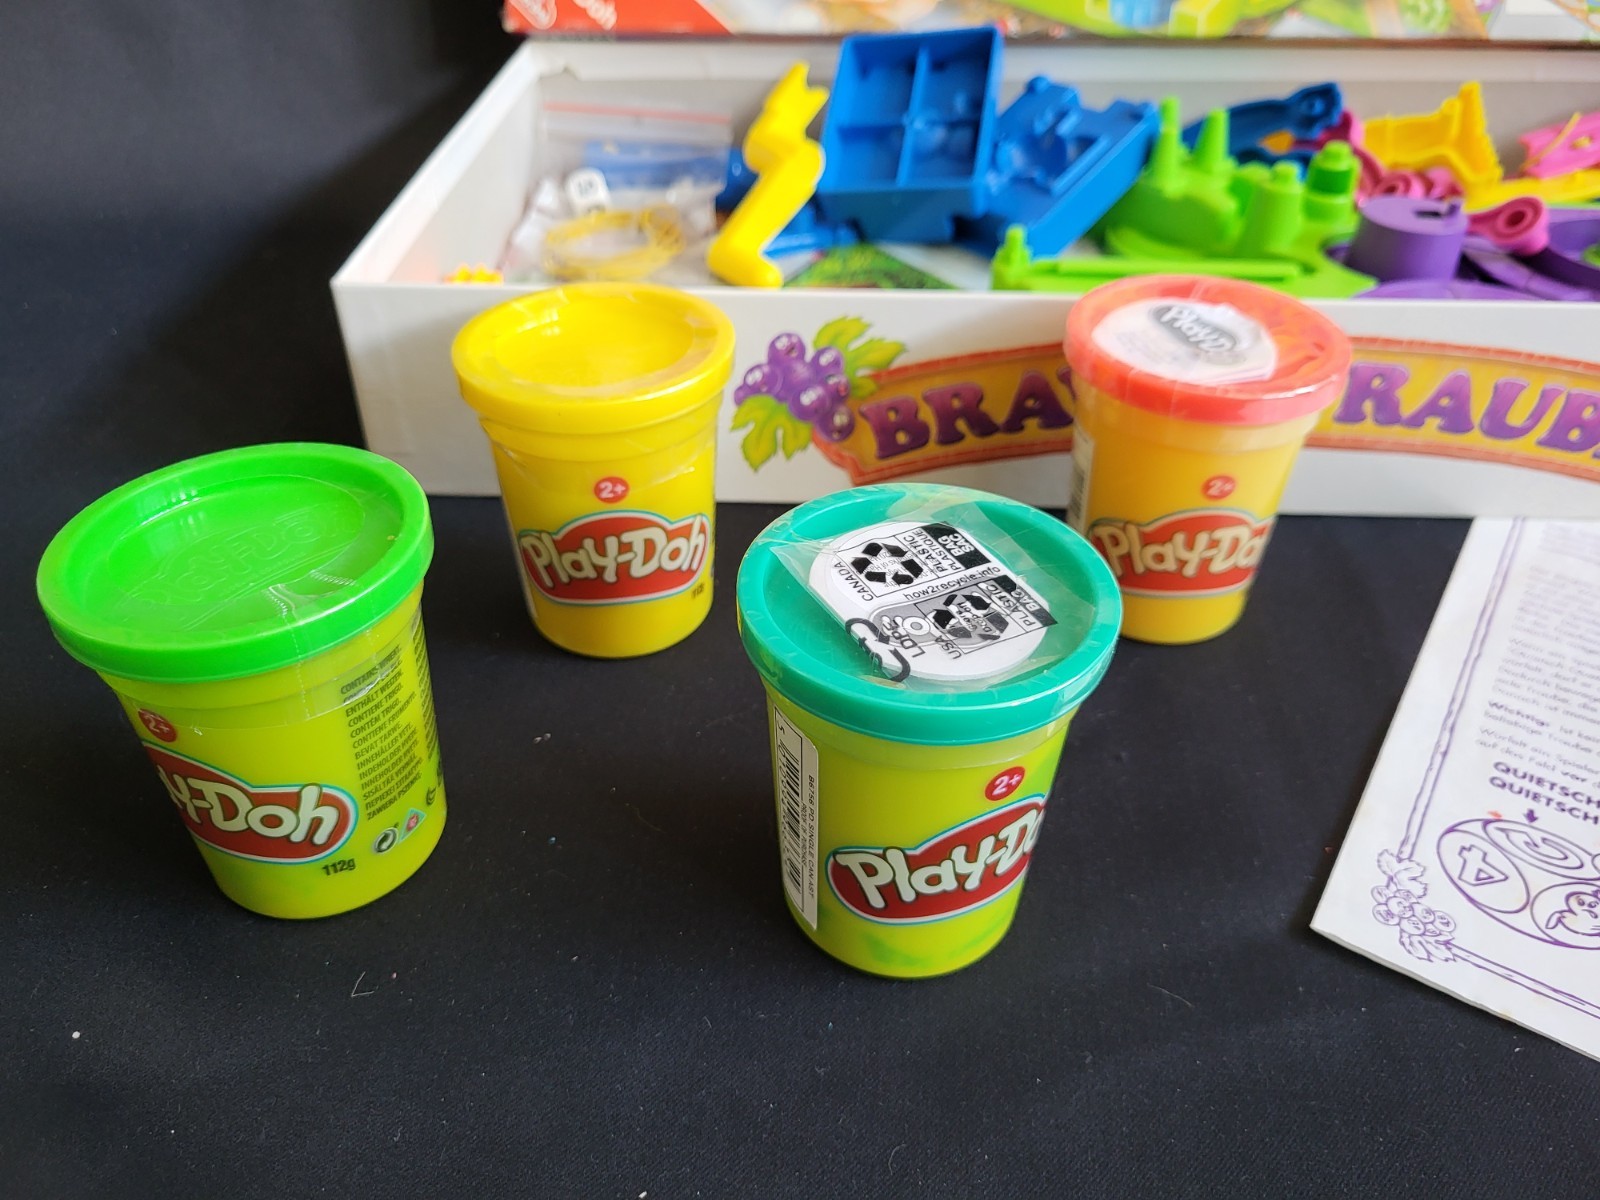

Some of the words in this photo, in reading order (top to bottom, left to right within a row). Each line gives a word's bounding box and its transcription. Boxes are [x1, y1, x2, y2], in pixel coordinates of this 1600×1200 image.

[859, 365, 1075, 459] BRA
[1333, 362, 1600, 459] RAUB
[599, 481, 627, 499] 2+
[519, 514, 707, 588] Play-Doh
[903, 535, 947, 573] PLASTIC
[912, 528, 962, 571] PLASTIQUE
[937, 534, 963, 557] BAG
[949, 533, 975, 553] SAC
[834, 561, 874, 602] CANADA
[903, 565, 1001, 601] how2recycle.info
[985, 584, 1036, 626] PLASTIC
[1010, 588, 1040, 612] BAG
[934, 635, 962, 660] USA
[348, 700, 383, 728] CONTIENE
[353, 721, 389, 749] CONTIENE
[355, 740, 379, 760] BEVAT
[993, 772, 1022, 796] 2+
[808, 806, 815, 822] PD
[322, 857, 356, 876] 112g
